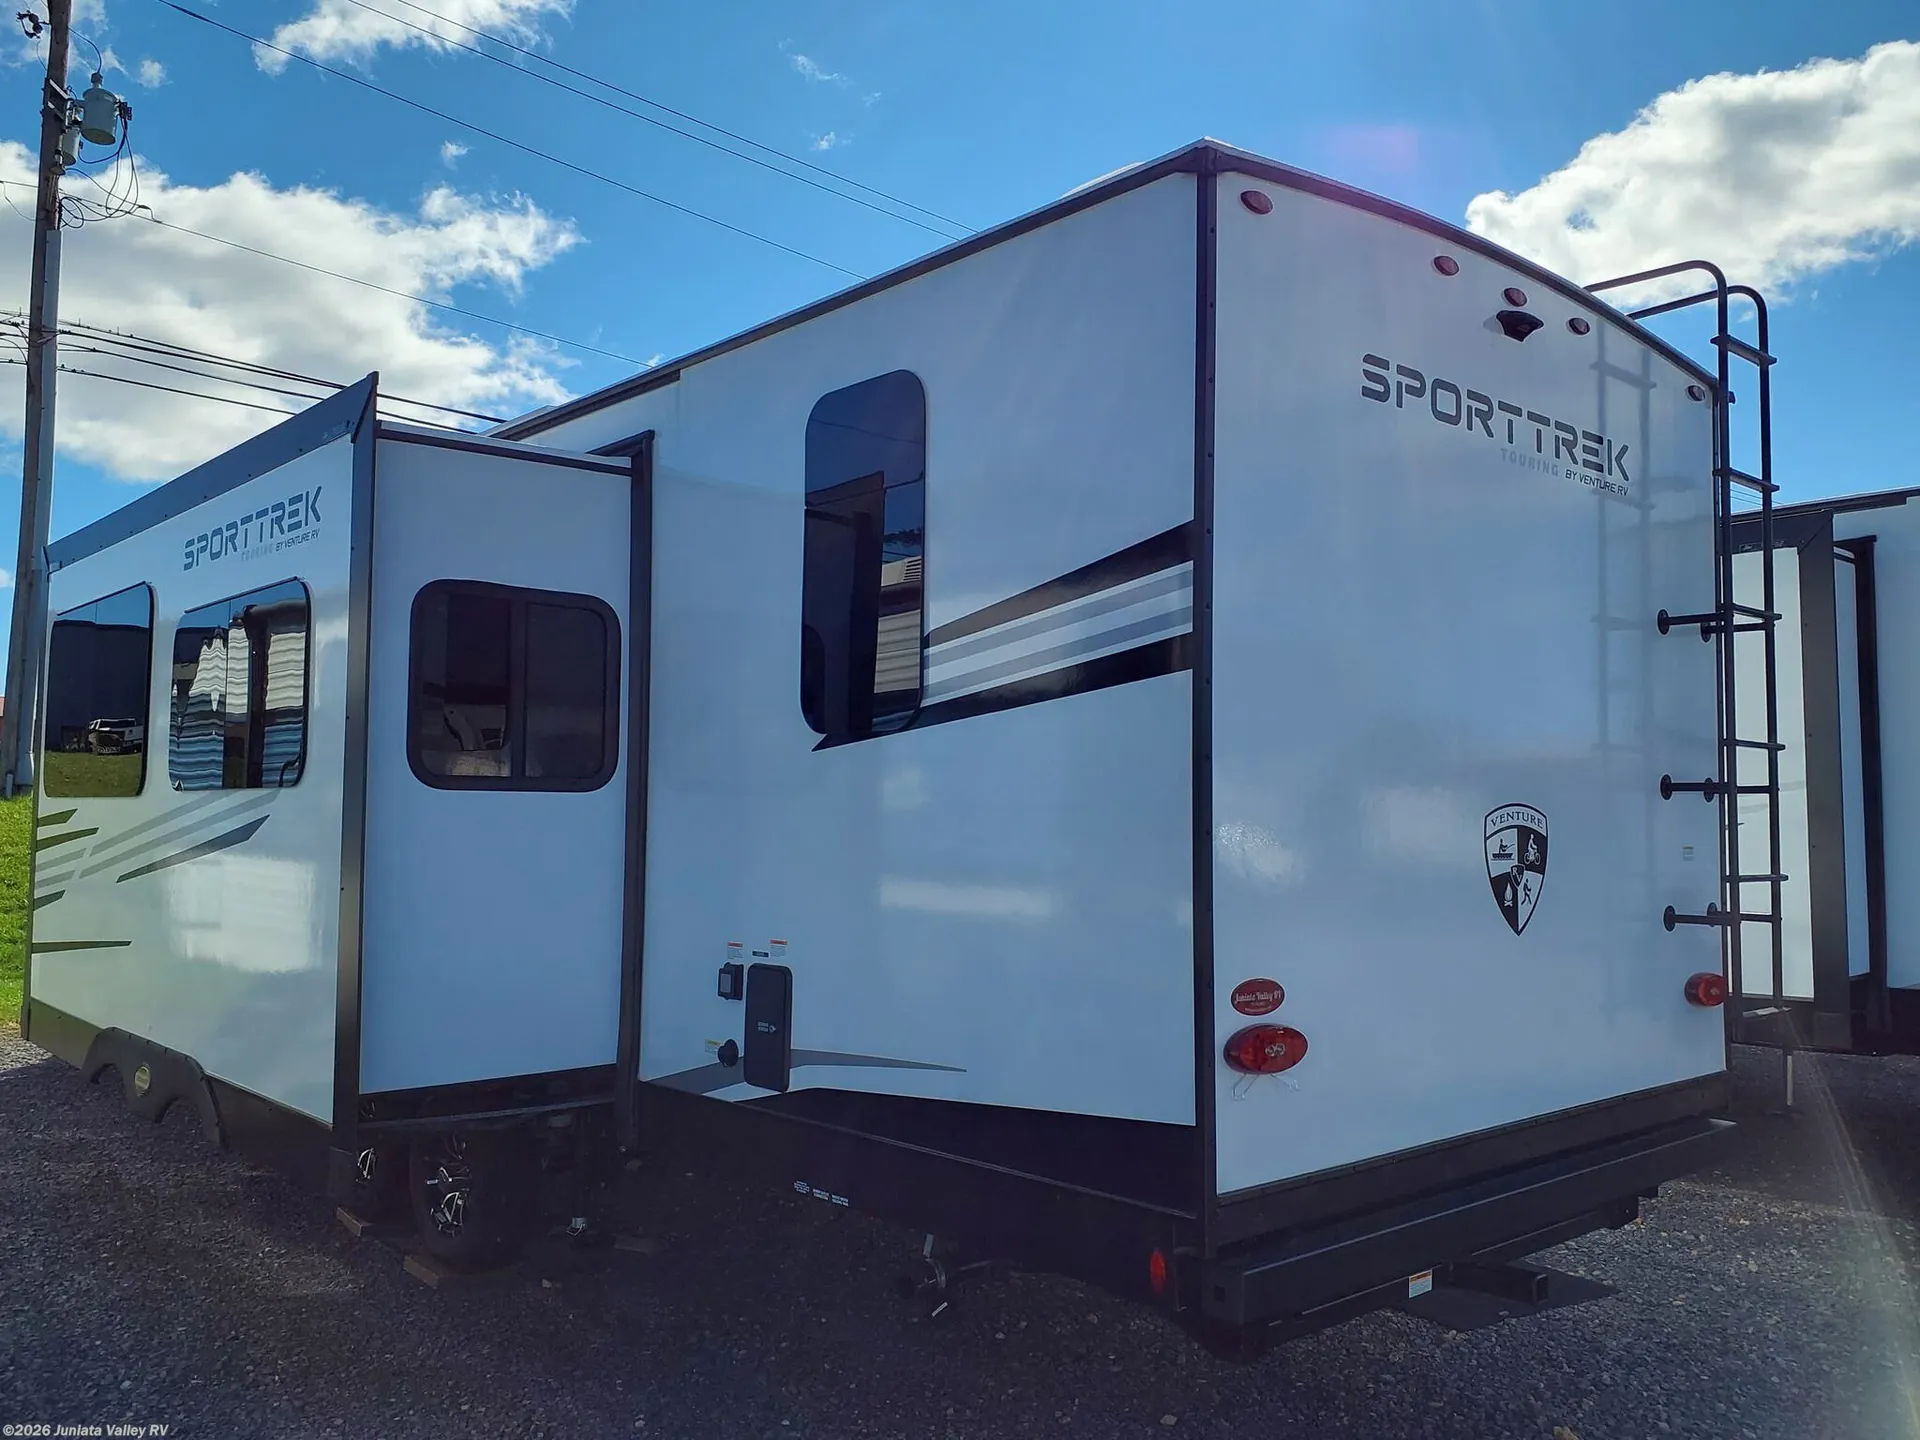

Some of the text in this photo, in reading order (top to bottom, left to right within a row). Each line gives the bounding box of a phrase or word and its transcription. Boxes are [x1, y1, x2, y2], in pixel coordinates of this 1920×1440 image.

[1361, 353, 1630, 482] SPORTTREK
[1500, 448, 1629, 496] TOURING BY VENTURE RV
[183, 485, 322, 571] SPORTTREK
[284, 533, 311, 549] VENTURE
[311, 528, 320, 541] RV
[1490, 811, 1544, 829] VENTURE
